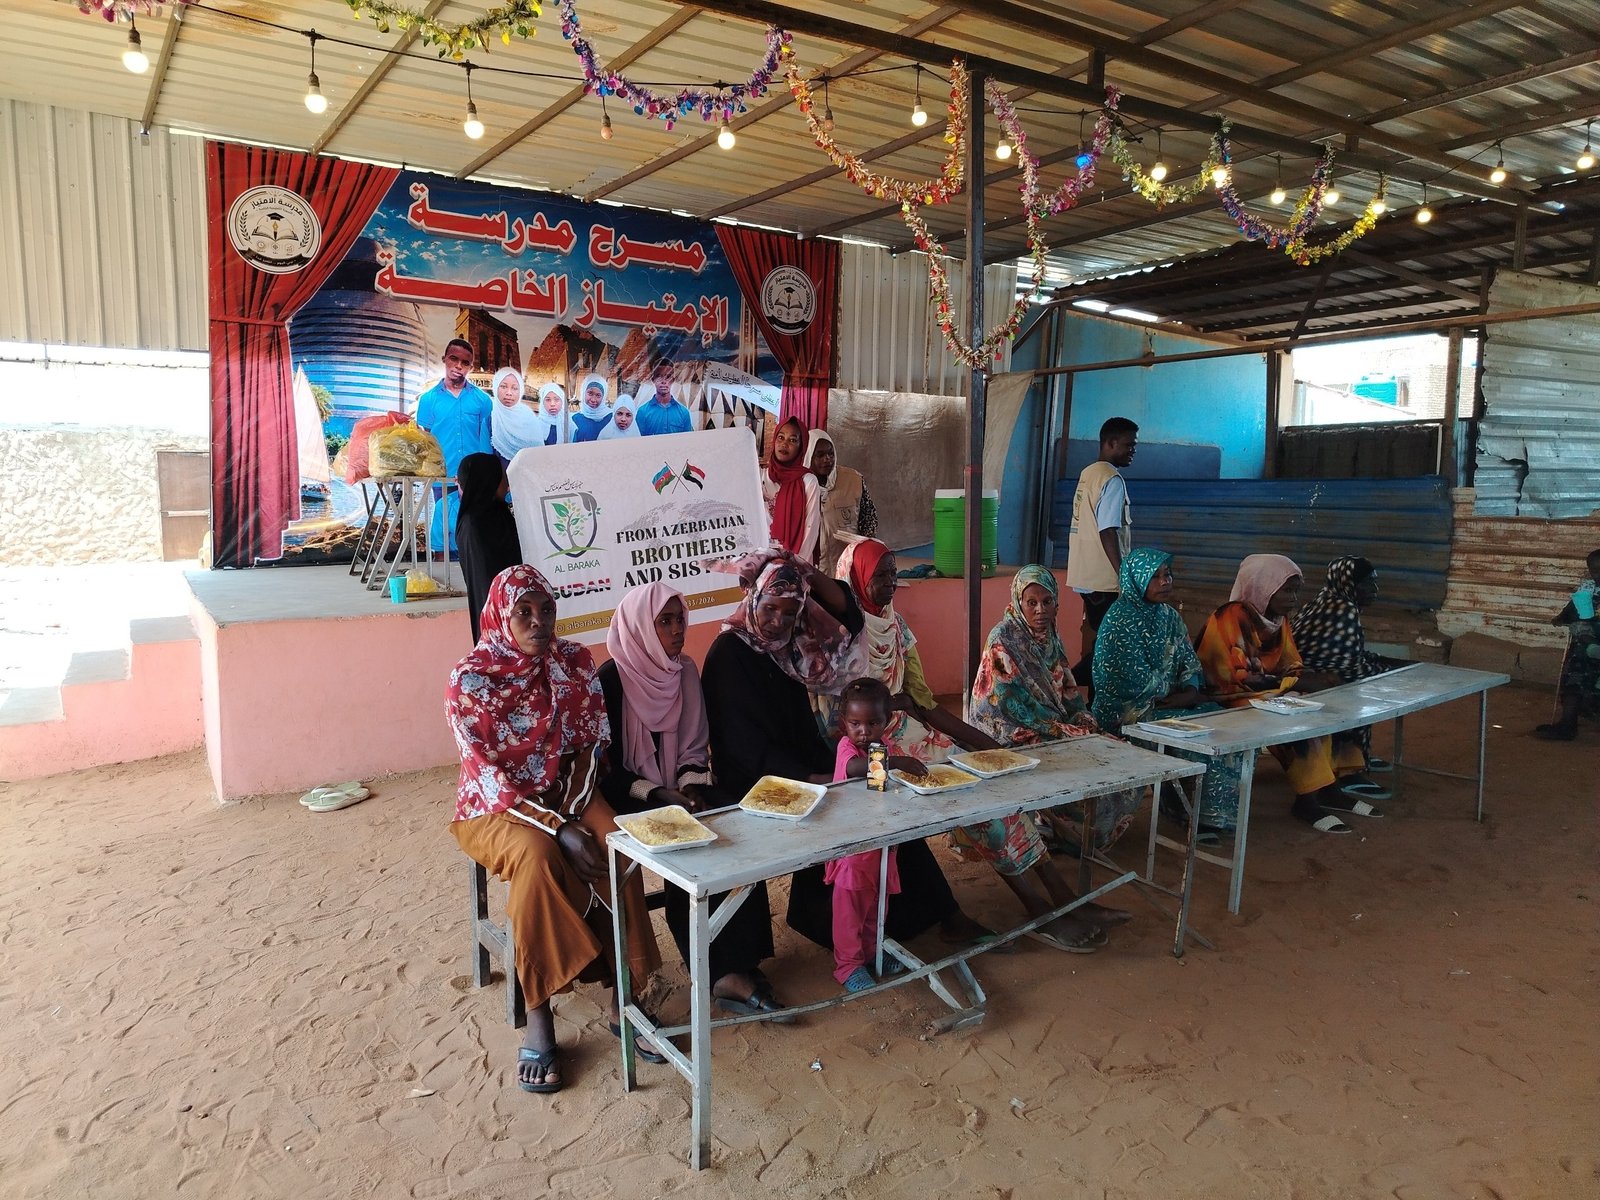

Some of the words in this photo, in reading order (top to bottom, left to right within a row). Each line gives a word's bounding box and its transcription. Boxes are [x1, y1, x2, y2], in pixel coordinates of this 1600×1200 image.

[407, 182, 577, 257] مدرسة
[589, 223, 707, 272] مسرح
[374, 250, 568, 319] الخاصة
[575, 280, 729, 348] الإمتياز
[616, 527, 657, 544] FROM
[661, 514, 745, 538] AZERBAIJAN
[554, 564, 566, 574] AL
[567, 559, 601, 572] BARAKA
[631, 534, 737, 567] BROTHERS
[552, 578, 611, 601] SUDAN
[623, 566, 663, 588] AND
